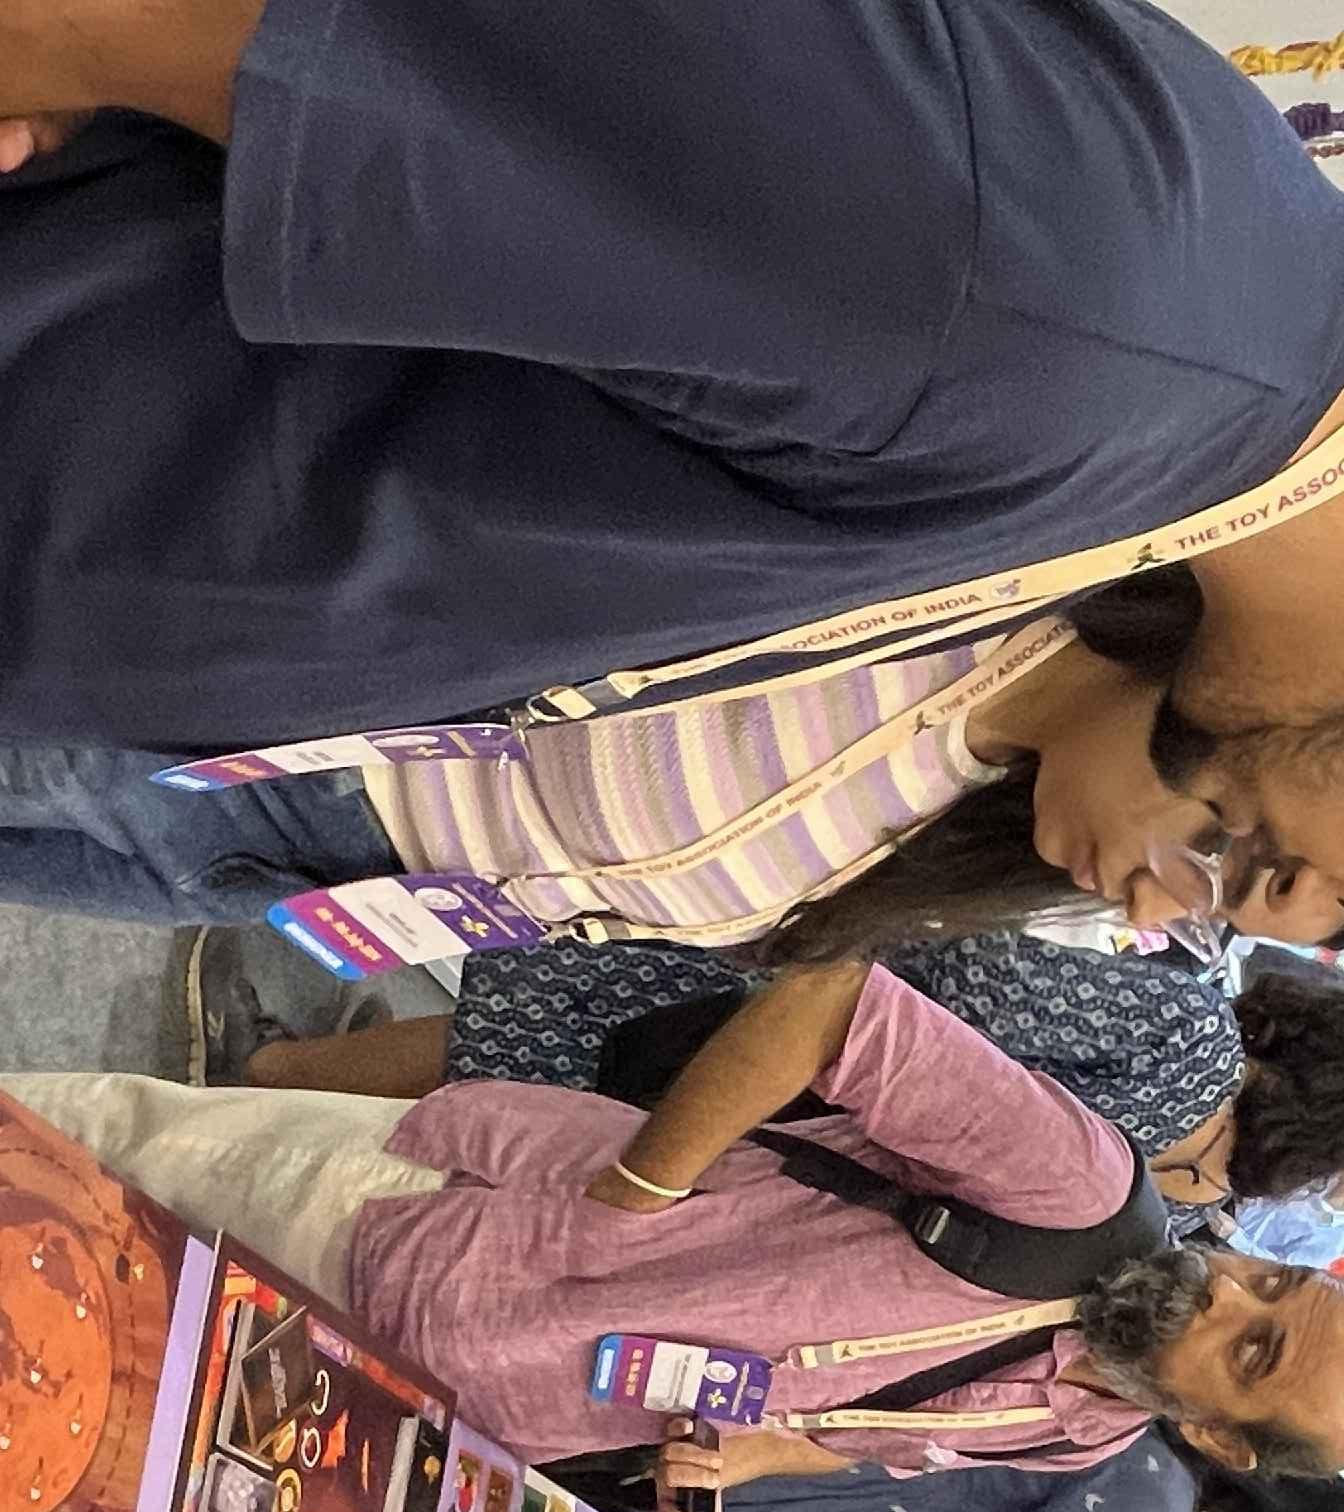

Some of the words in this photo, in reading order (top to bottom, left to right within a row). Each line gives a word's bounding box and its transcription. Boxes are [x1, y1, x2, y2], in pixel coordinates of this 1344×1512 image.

[1174, 525, 1223, 551] THE
[1225, 503, 1273, 532] TOY
[891, 608, 917, 622] OF
[924, 593, 982, 615] INDIA
[967, 674, 994, 698] TOY
